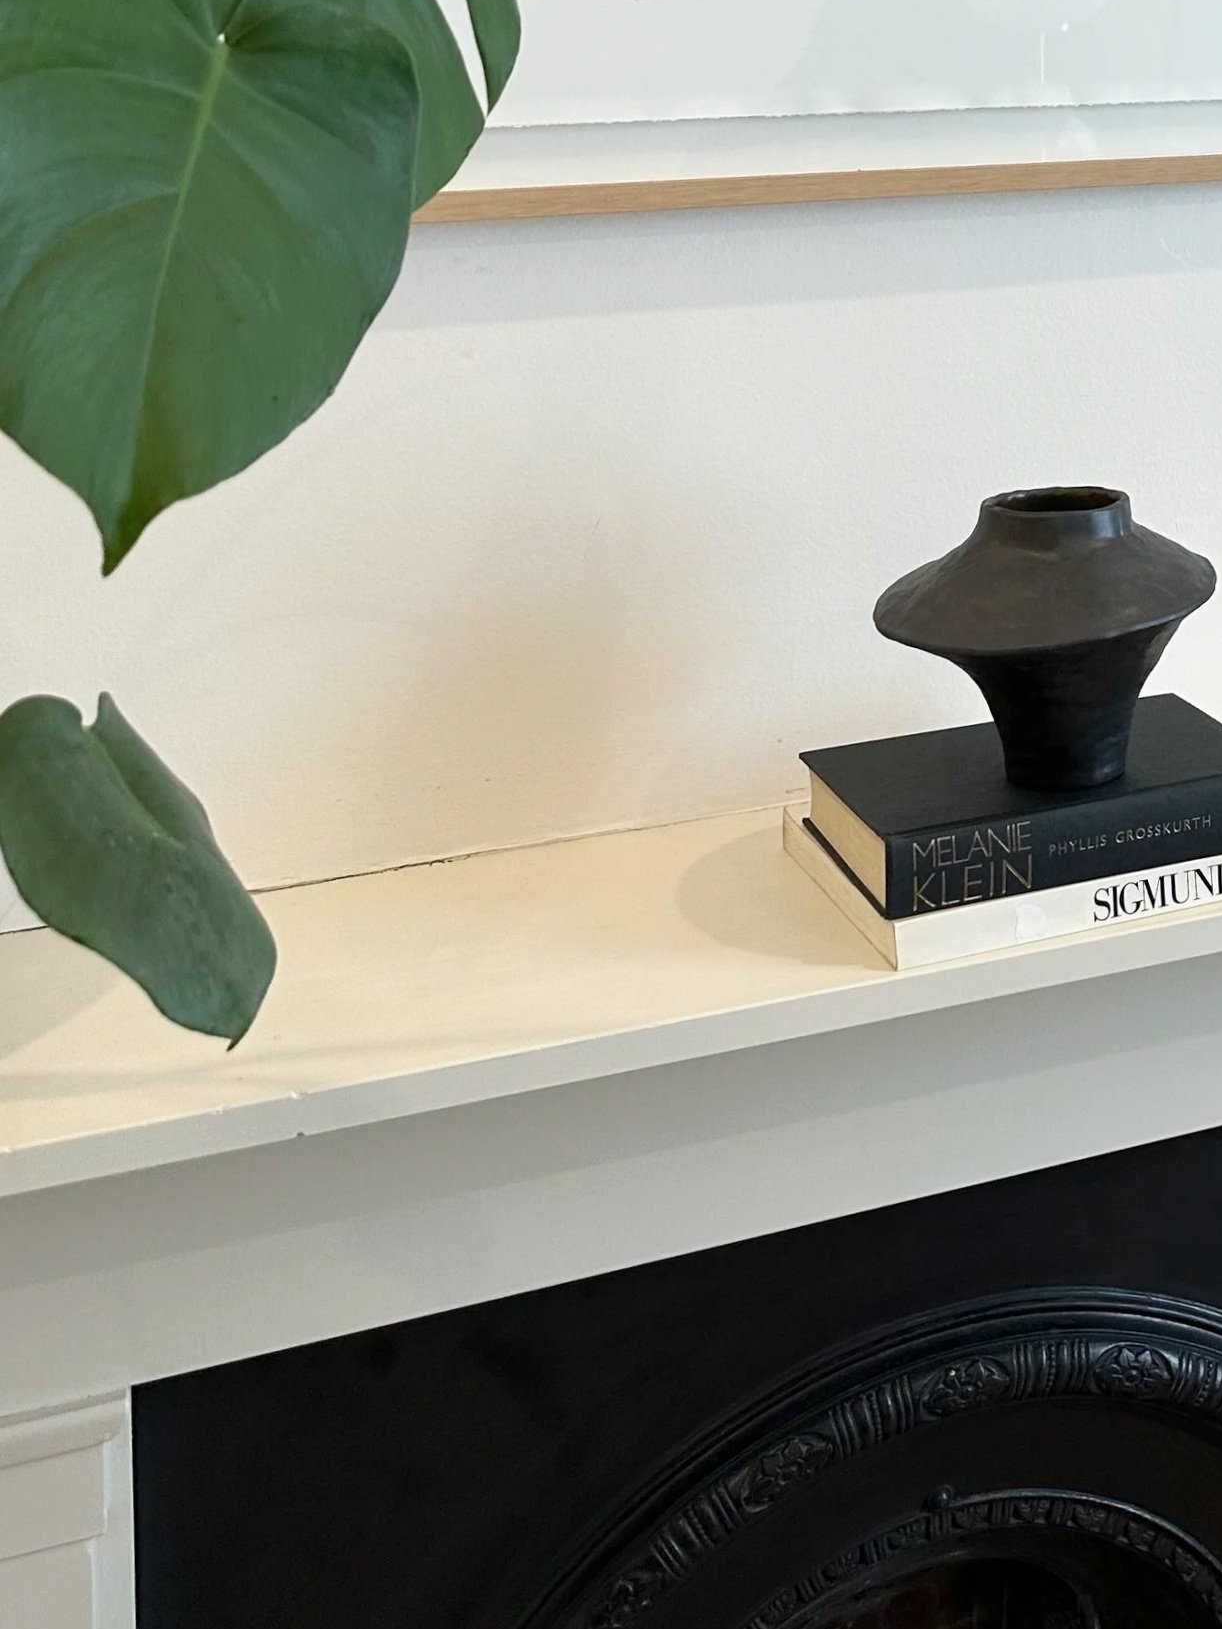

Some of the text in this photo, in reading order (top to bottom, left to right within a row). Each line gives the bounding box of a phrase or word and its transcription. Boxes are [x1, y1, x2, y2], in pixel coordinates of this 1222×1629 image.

[911, 820, 1033, 872] MELANIE
[1048, 813, 1213, 856] PHYLLIS GROSSKURTH
[911, 852, 1033, 912] KLEIN
